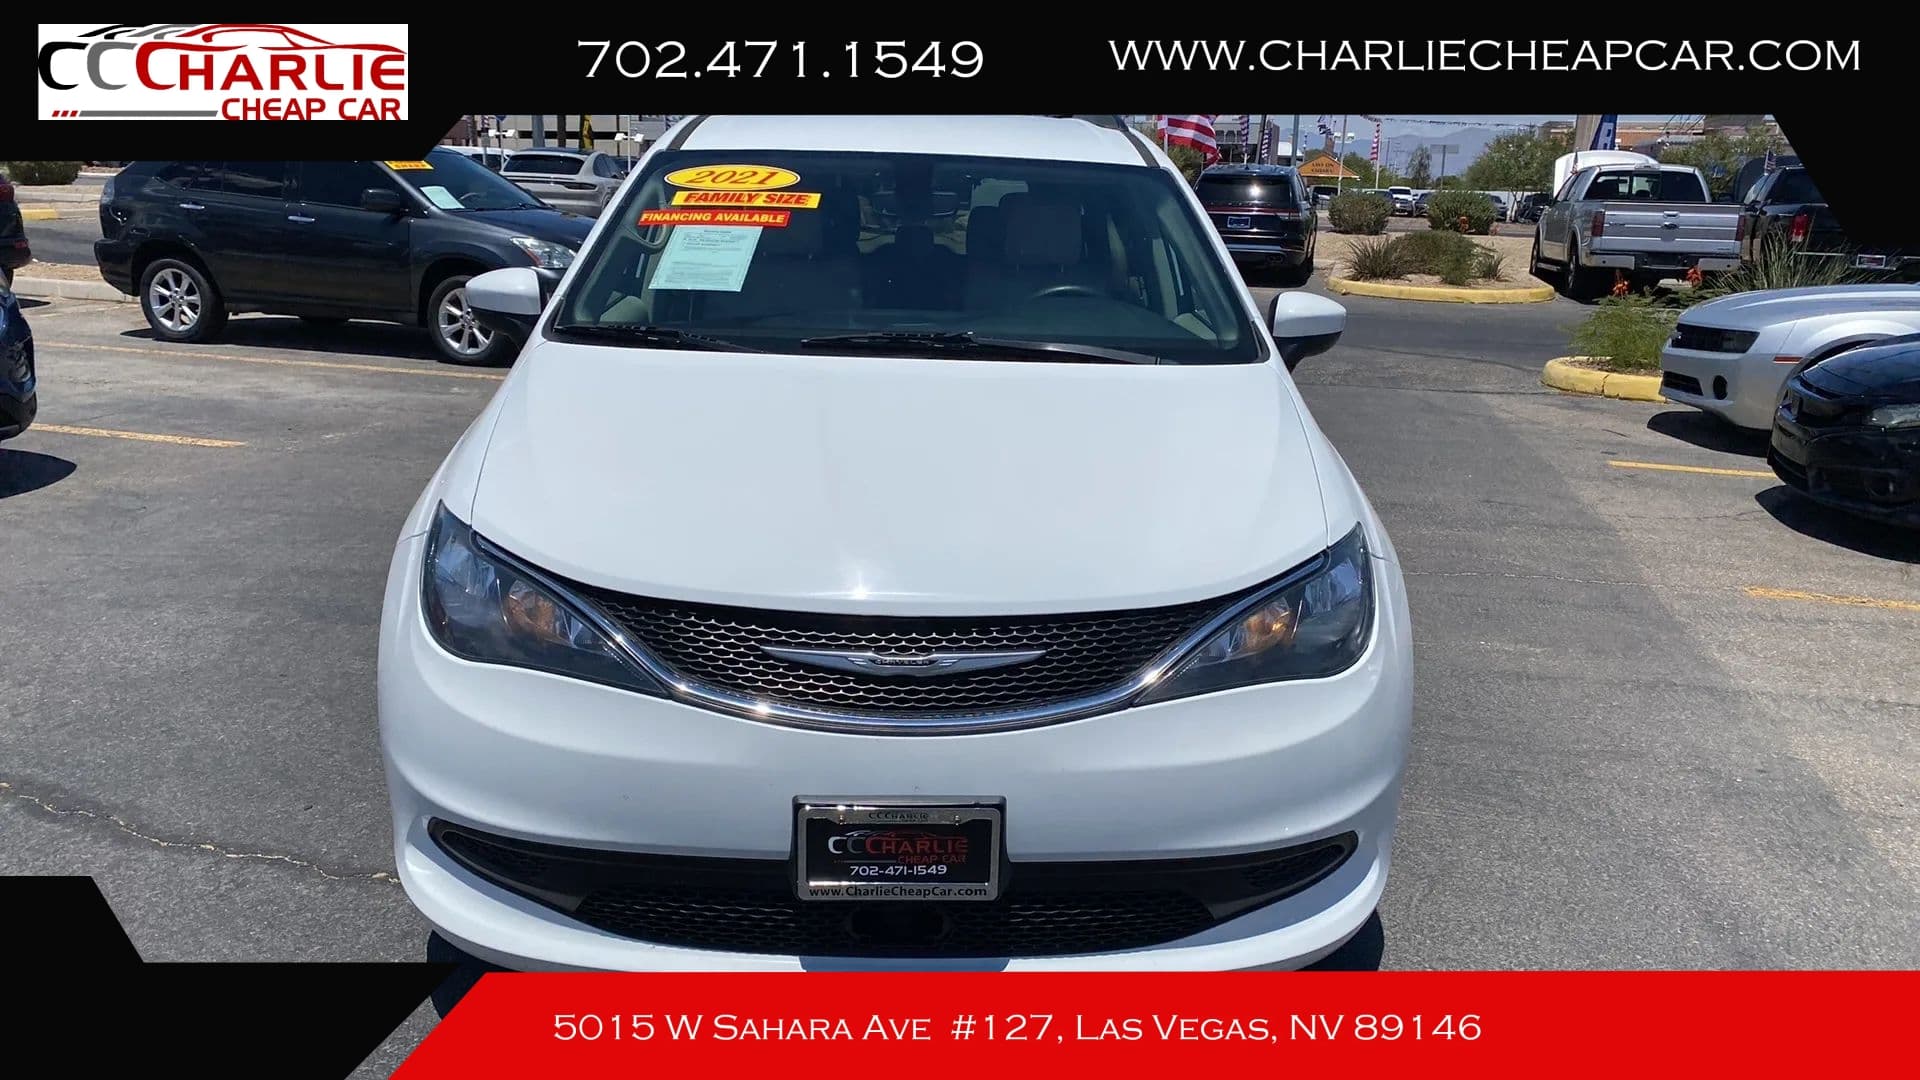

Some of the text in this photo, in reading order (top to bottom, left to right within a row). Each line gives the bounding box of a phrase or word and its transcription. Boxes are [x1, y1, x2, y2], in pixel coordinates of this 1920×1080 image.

[685, 170, 779, 185] 2021
[684, 192, 810, 205] FAMILY SIZE
[641, 212, 786, 223] FINANCING AVAILABLE
[897, 855, 968, 864] CHEAP CAR
[849, 865, 948, 876] 702-471-1549
[809, 886, 988, 898] www.CharlieCheapCar.com
